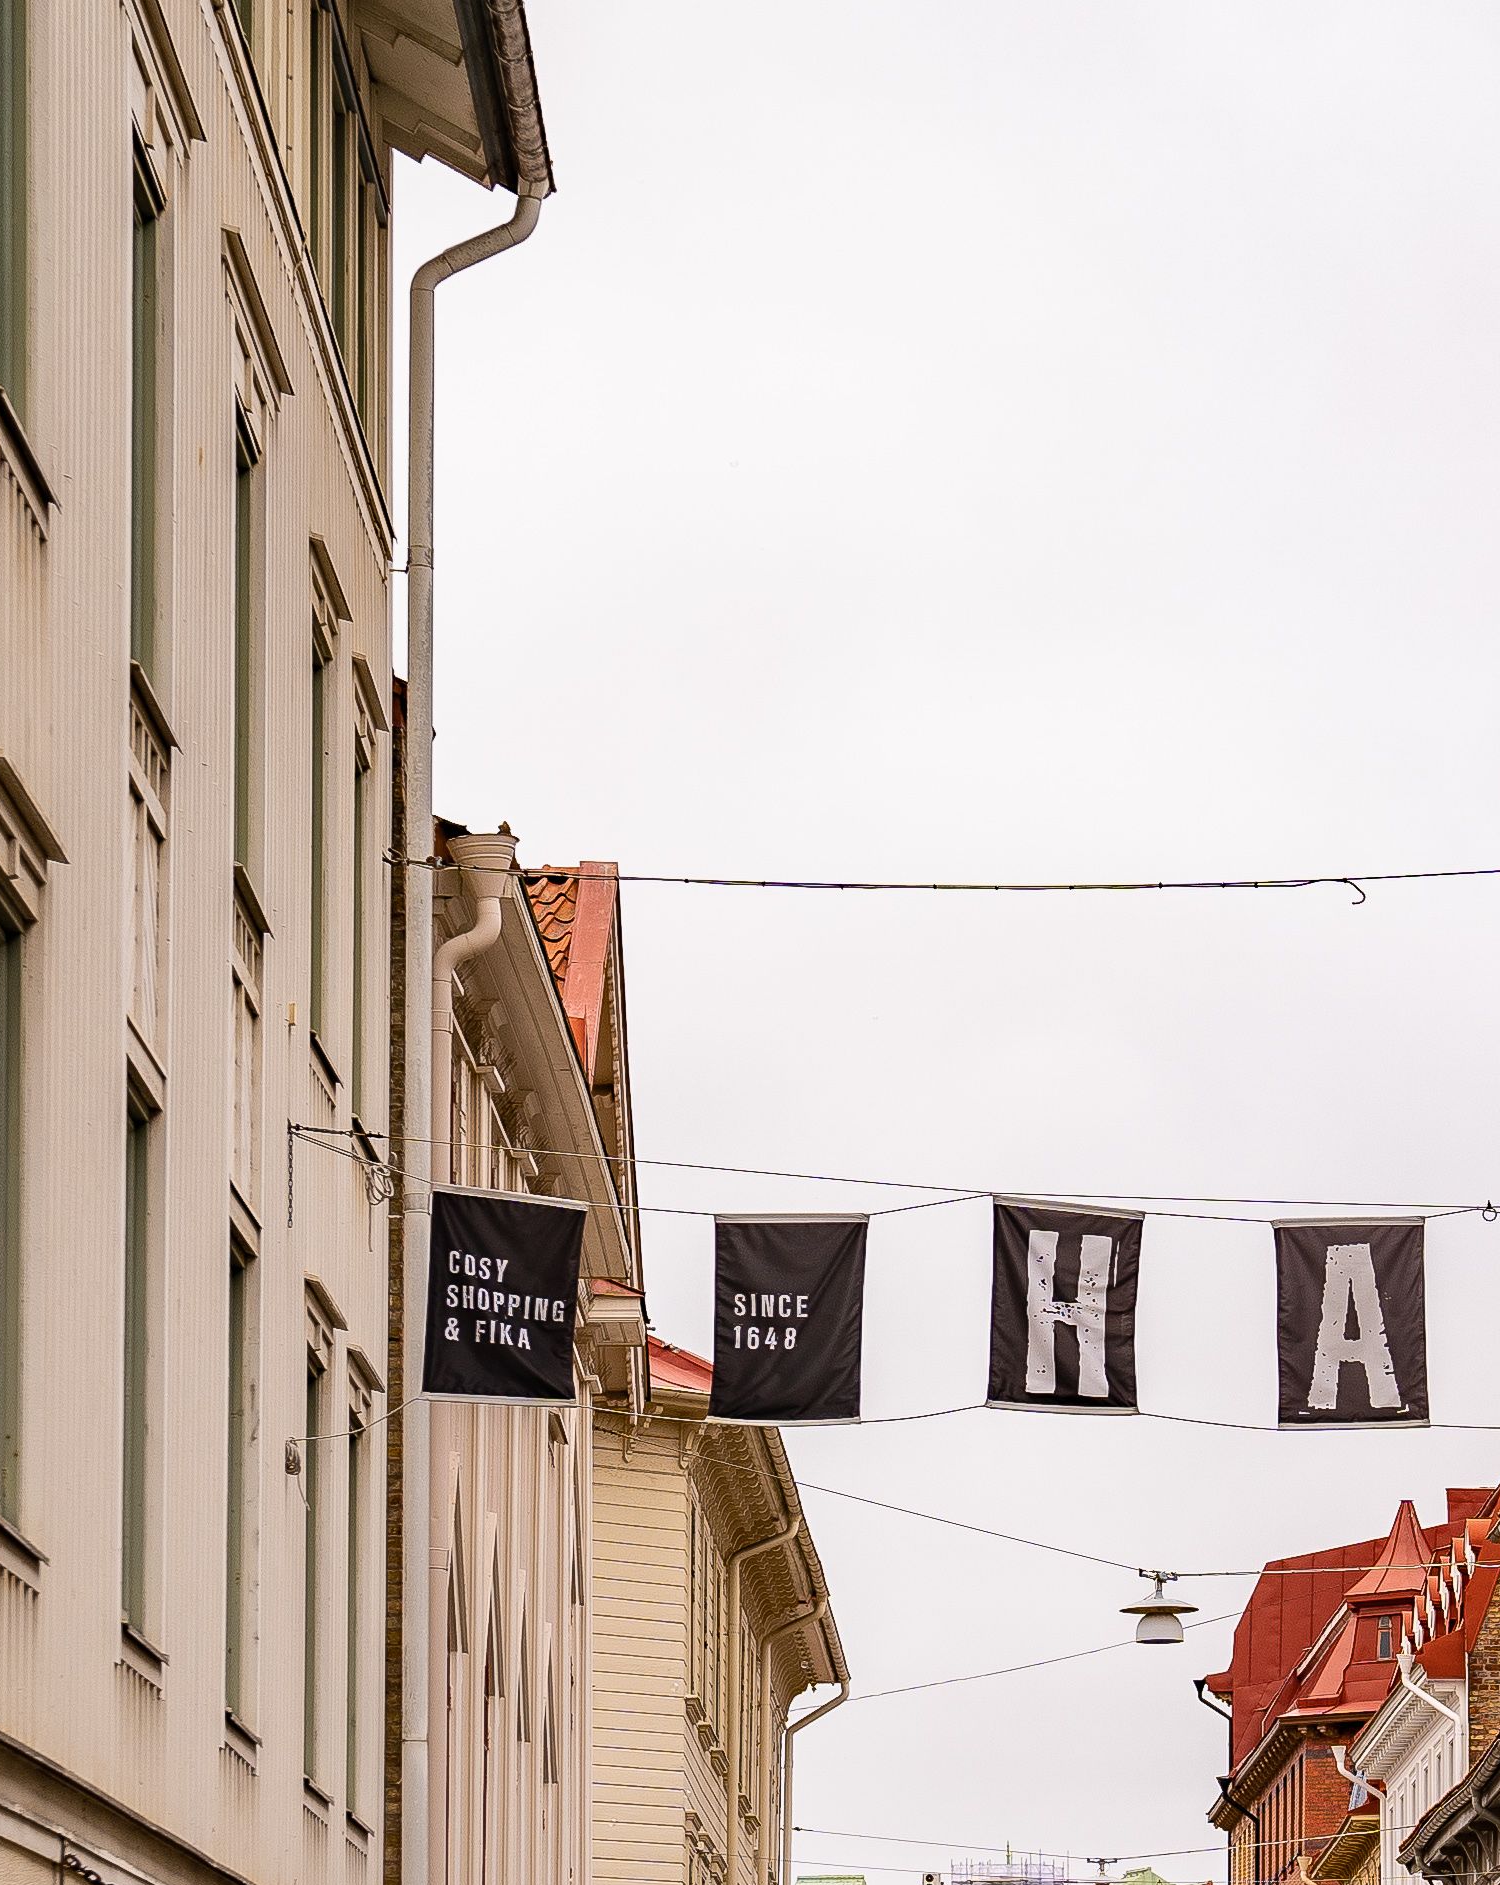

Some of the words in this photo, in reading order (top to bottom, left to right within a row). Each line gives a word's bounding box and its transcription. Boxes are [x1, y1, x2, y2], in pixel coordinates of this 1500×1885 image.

[447, 1249, 509, 1285] COSY
[445, 1283, 567, 1325] SHOPPING
[732, 1292, 810, 1320] SINCE
[444, 1316, 461, 1342] &
[474, 1319, 534, 1352] FIKA
[731, 1325, 799, 1353] 1648
